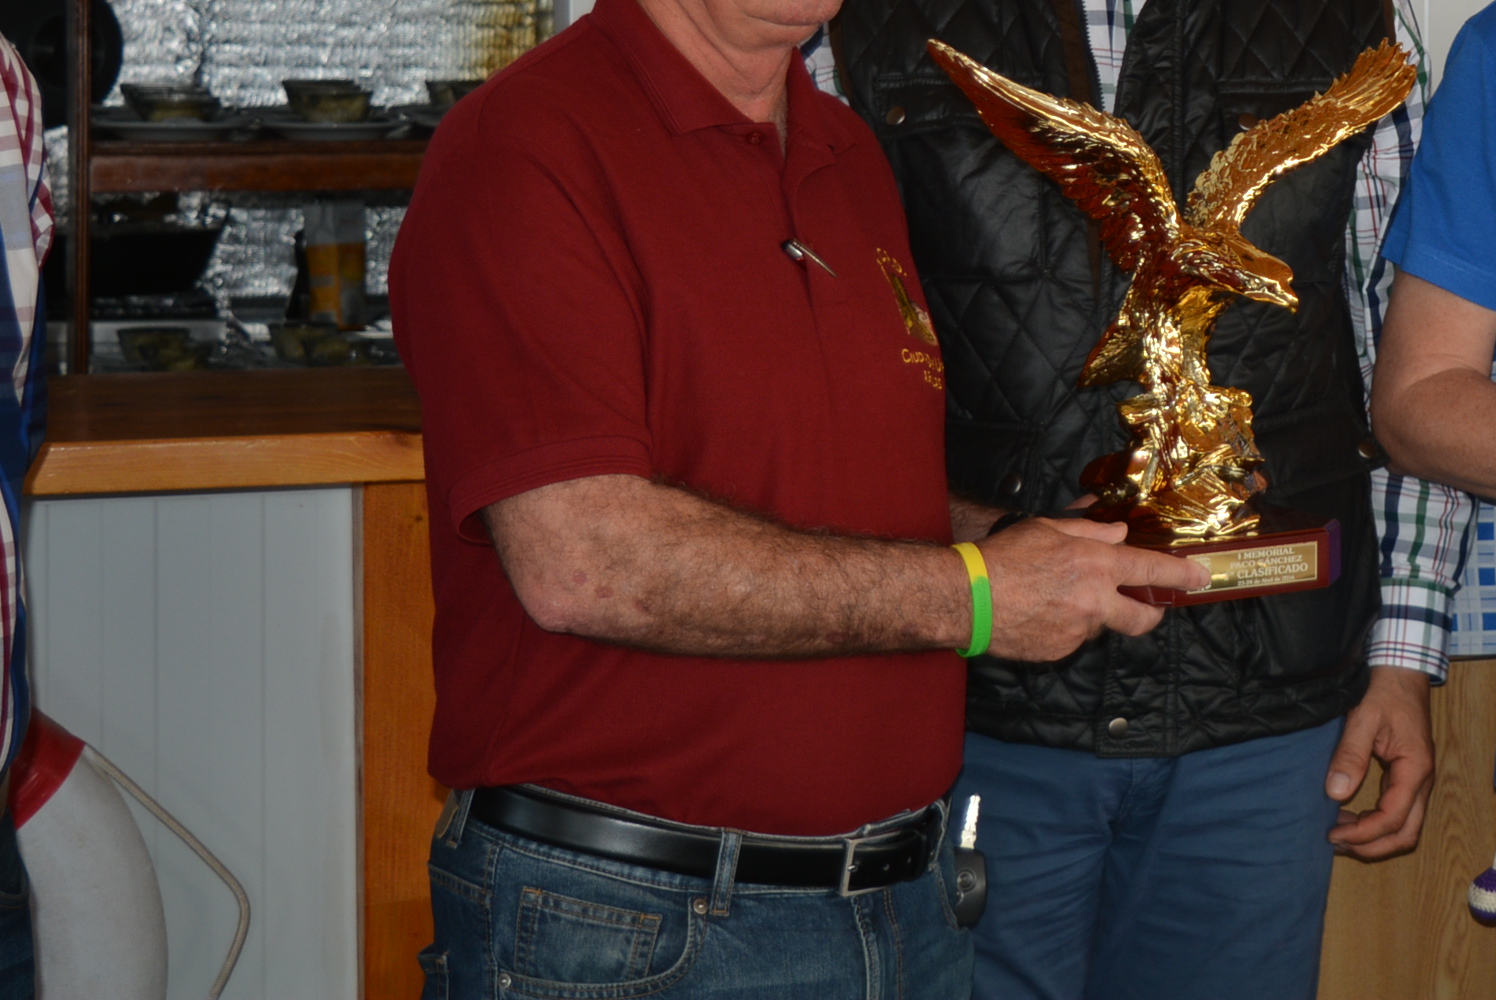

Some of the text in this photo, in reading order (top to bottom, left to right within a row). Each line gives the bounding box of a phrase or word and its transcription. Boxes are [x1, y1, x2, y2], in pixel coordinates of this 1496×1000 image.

[1244, 547, 1294, 559] MEMORIAL
[1230, 560, 1255, 569] PACO
[1237, 562, 1308, 579] CLASIFICADO
